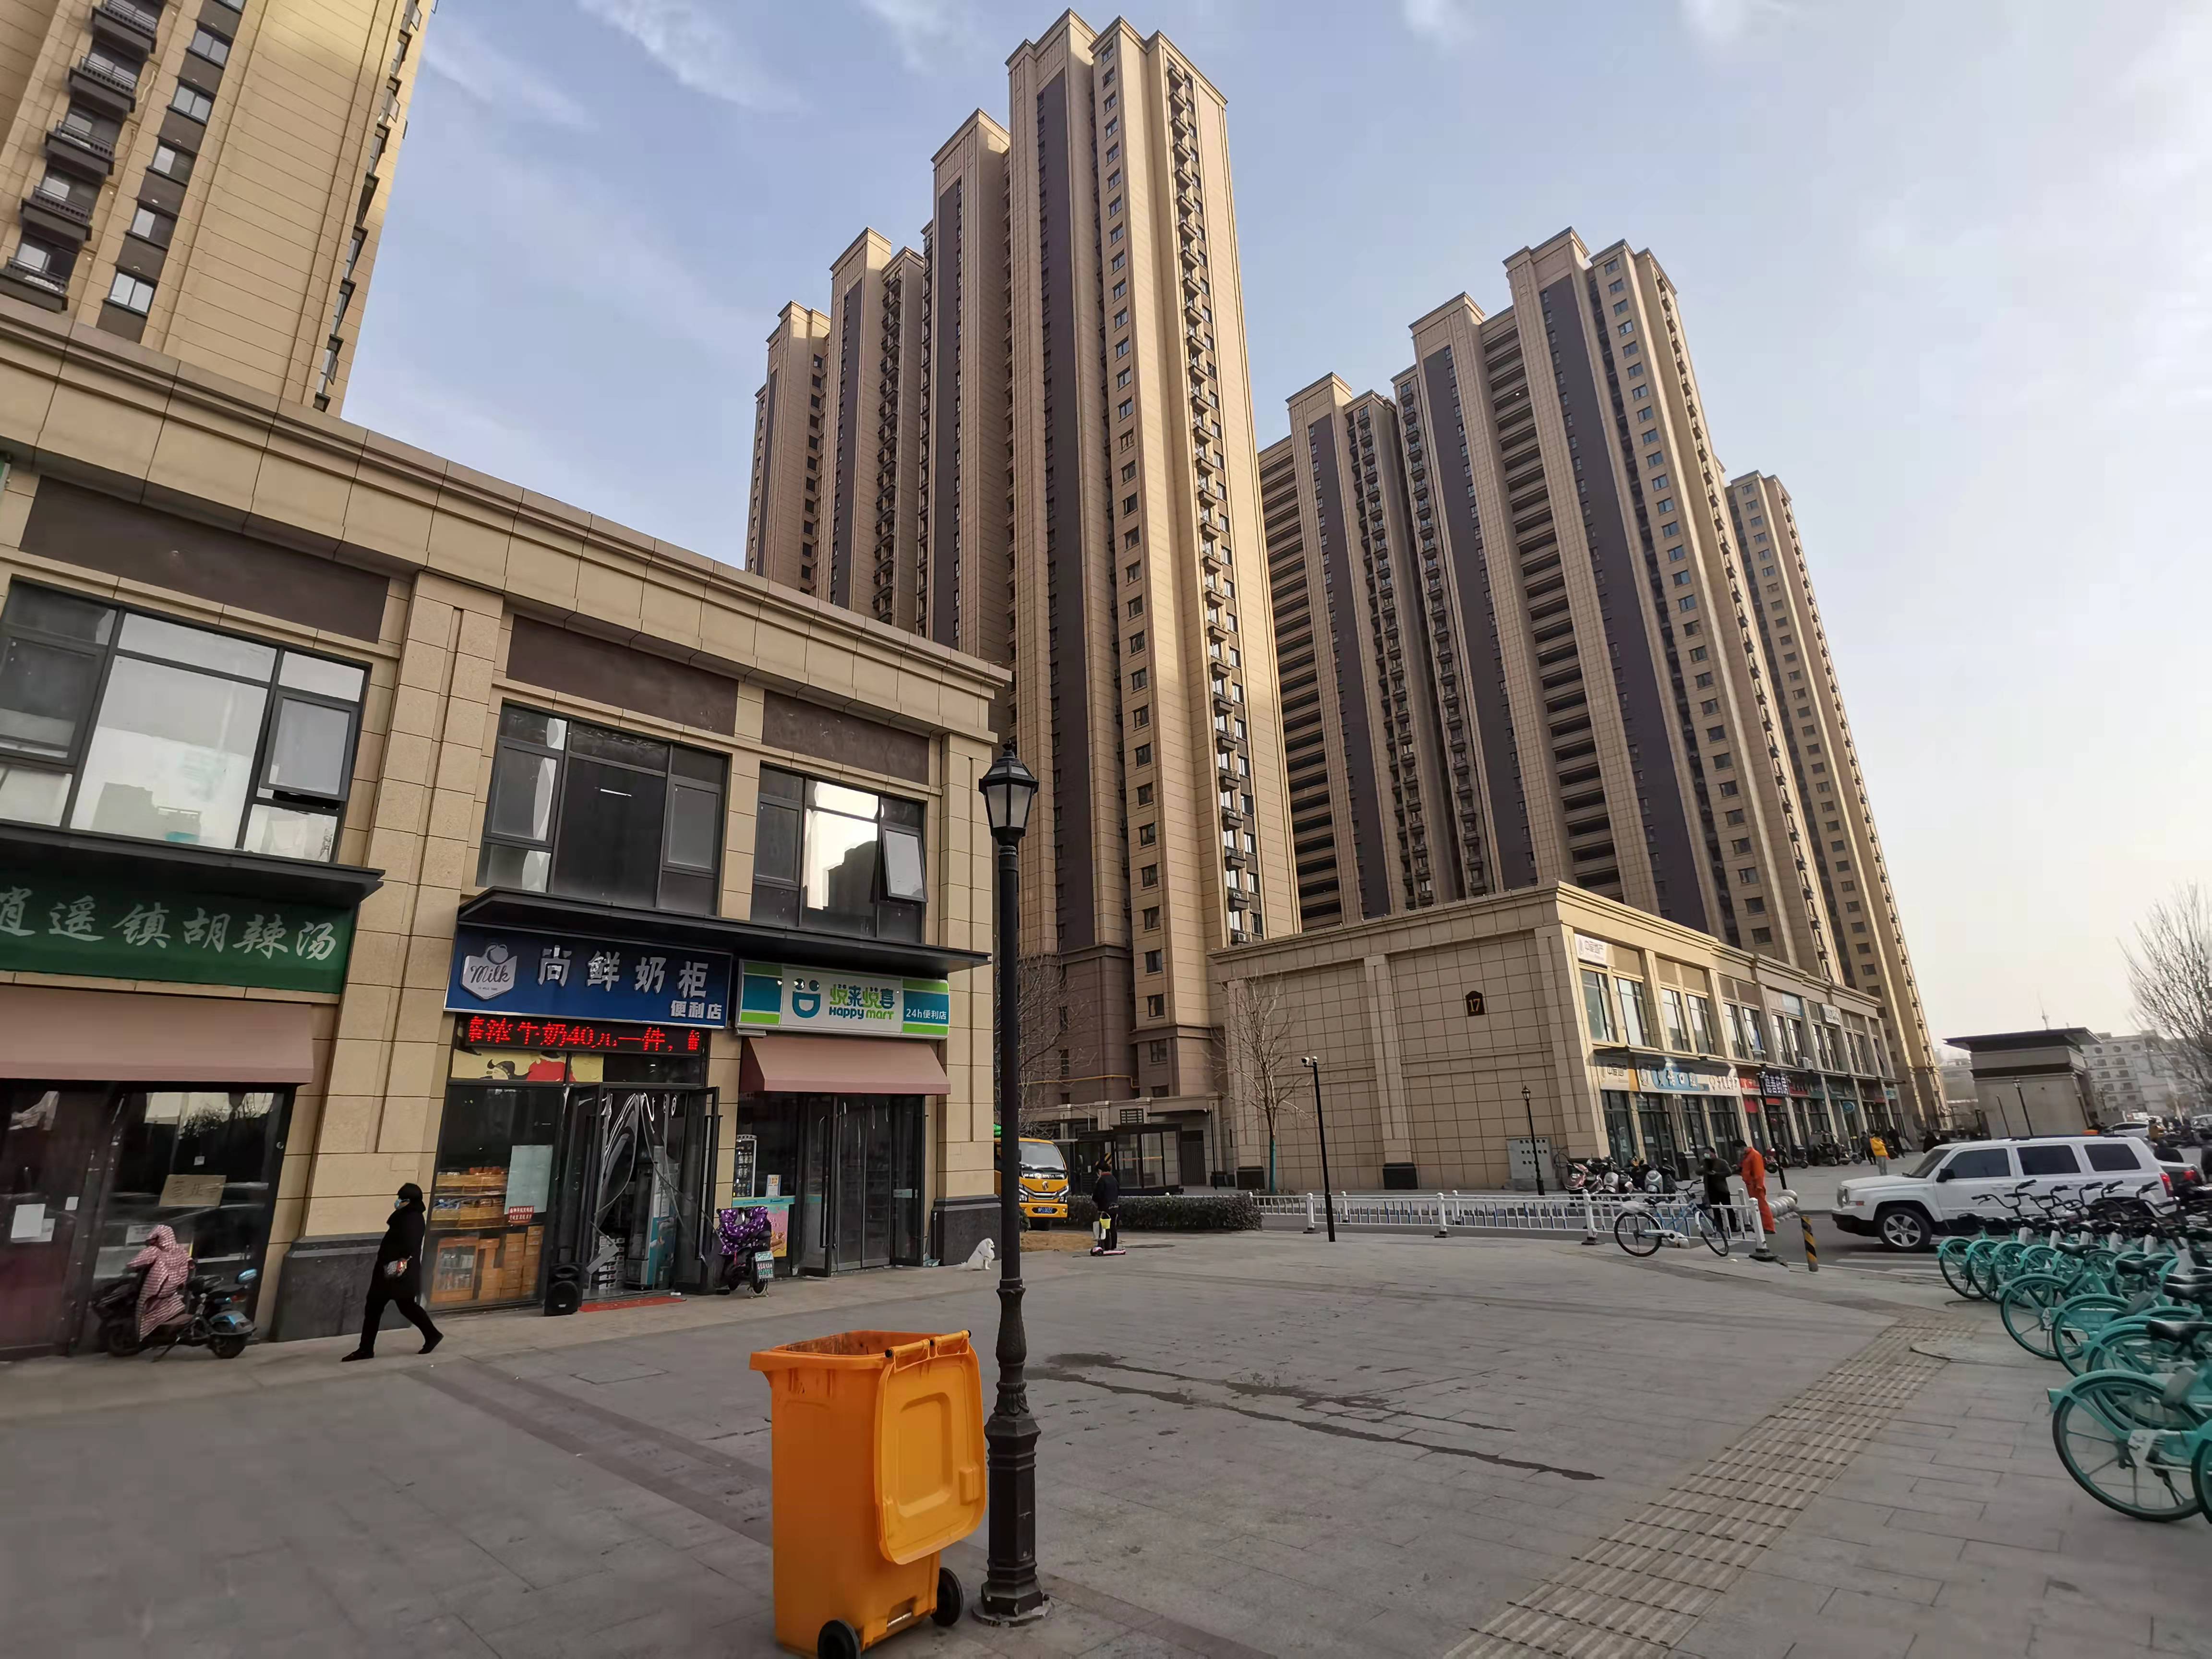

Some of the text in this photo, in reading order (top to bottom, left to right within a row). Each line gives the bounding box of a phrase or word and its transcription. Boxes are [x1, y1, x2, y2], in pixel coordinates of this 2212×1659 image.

[470, 965, 510, 983] Milk
[537, 945, 709, 998] 尚鲜奶柜
[830, 984, 895, 1009] 悦来悦喜
[1468, 998, 1480, 1012] 17
[671, 1000, 722, 1020] 便利店
[829, 1006, 865, 1020] Happy
[906, 1008, 947, 1020] 24h便利店
